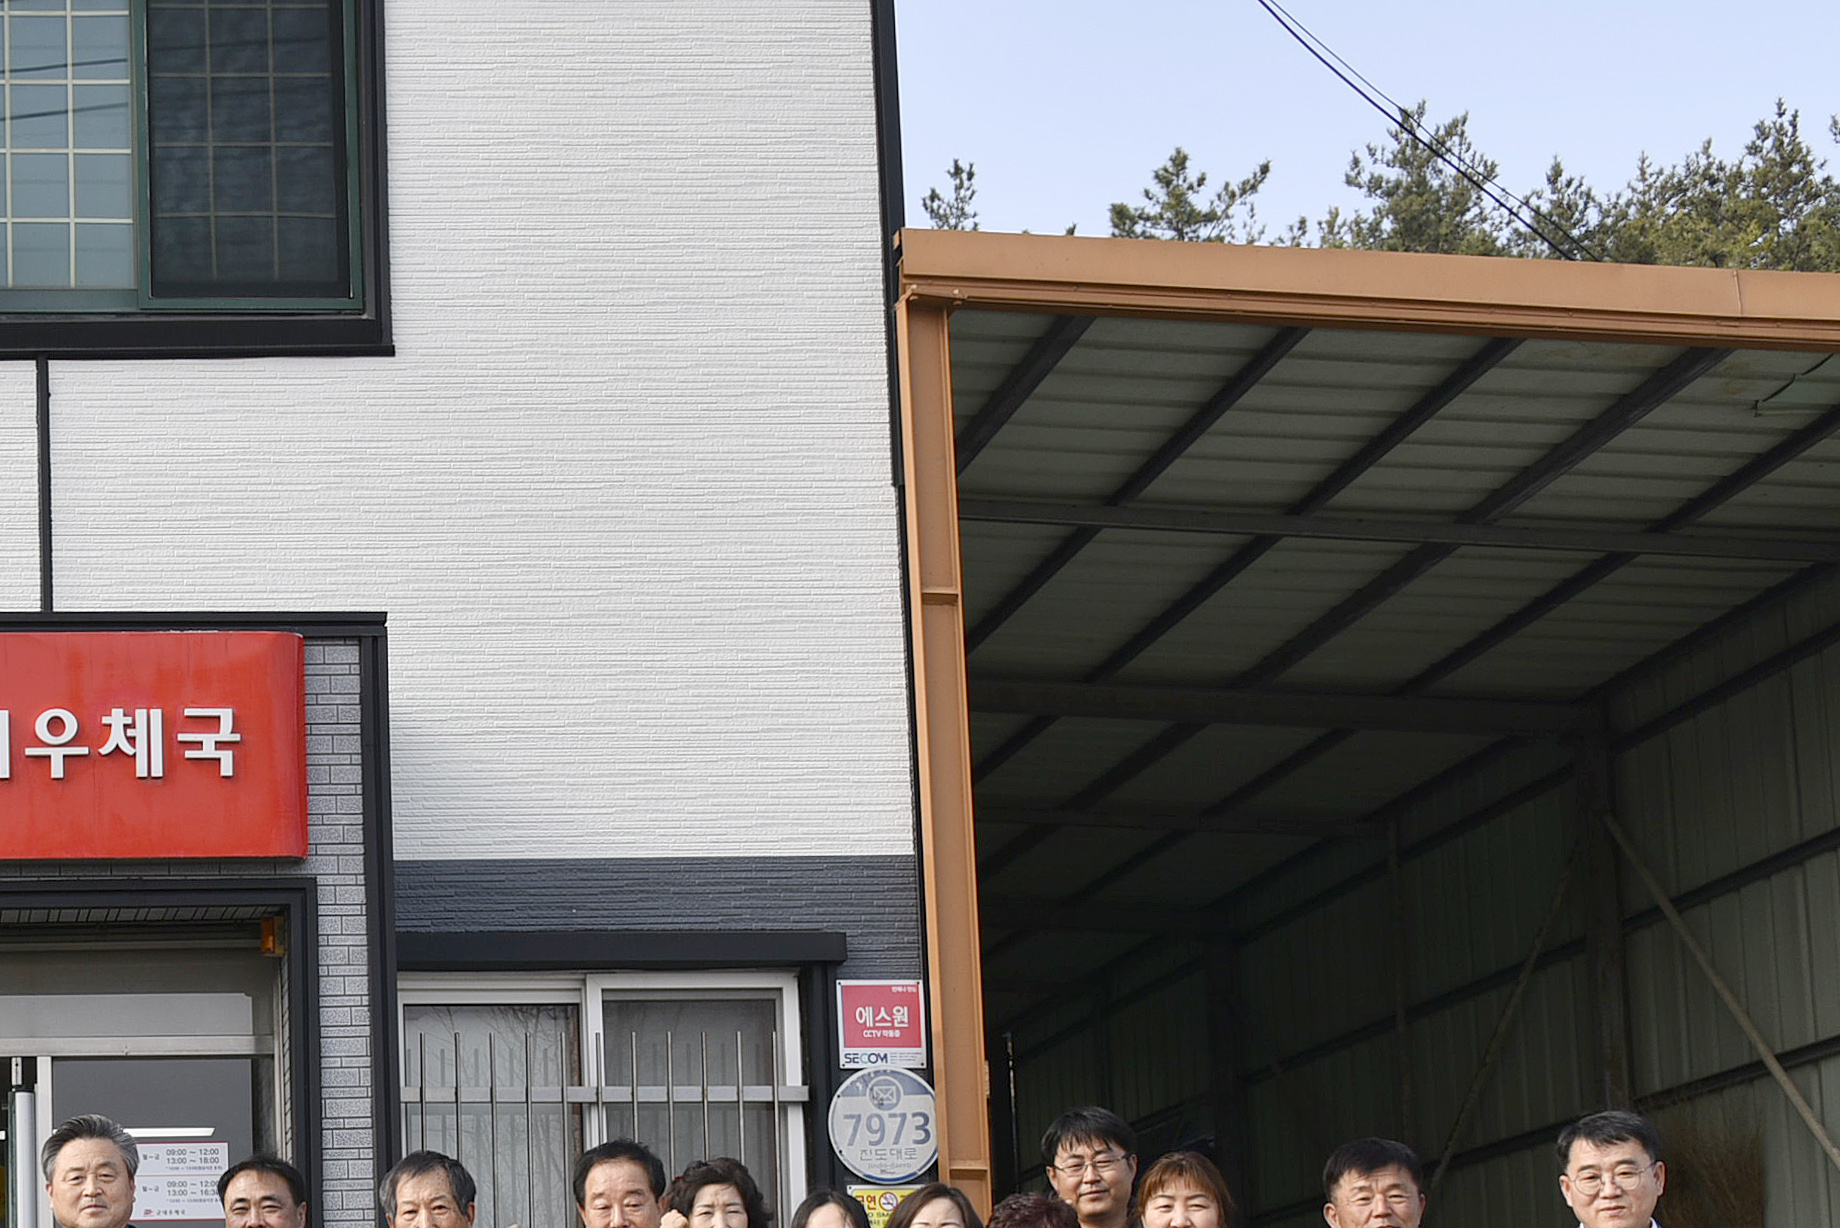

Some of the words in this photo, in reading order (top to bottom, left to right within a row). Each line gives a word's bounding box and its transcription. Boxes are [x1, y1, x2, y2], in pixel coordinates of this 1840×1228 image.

[855, 1006, 909, 1027] 에스원
[863, 1030, 882, 1038] CCTV
[844, 1053, 888, 1064] SECOM
[843, 1112, 931, 1147] 7973
[860, 1148, 918, 1161] 진도대로
